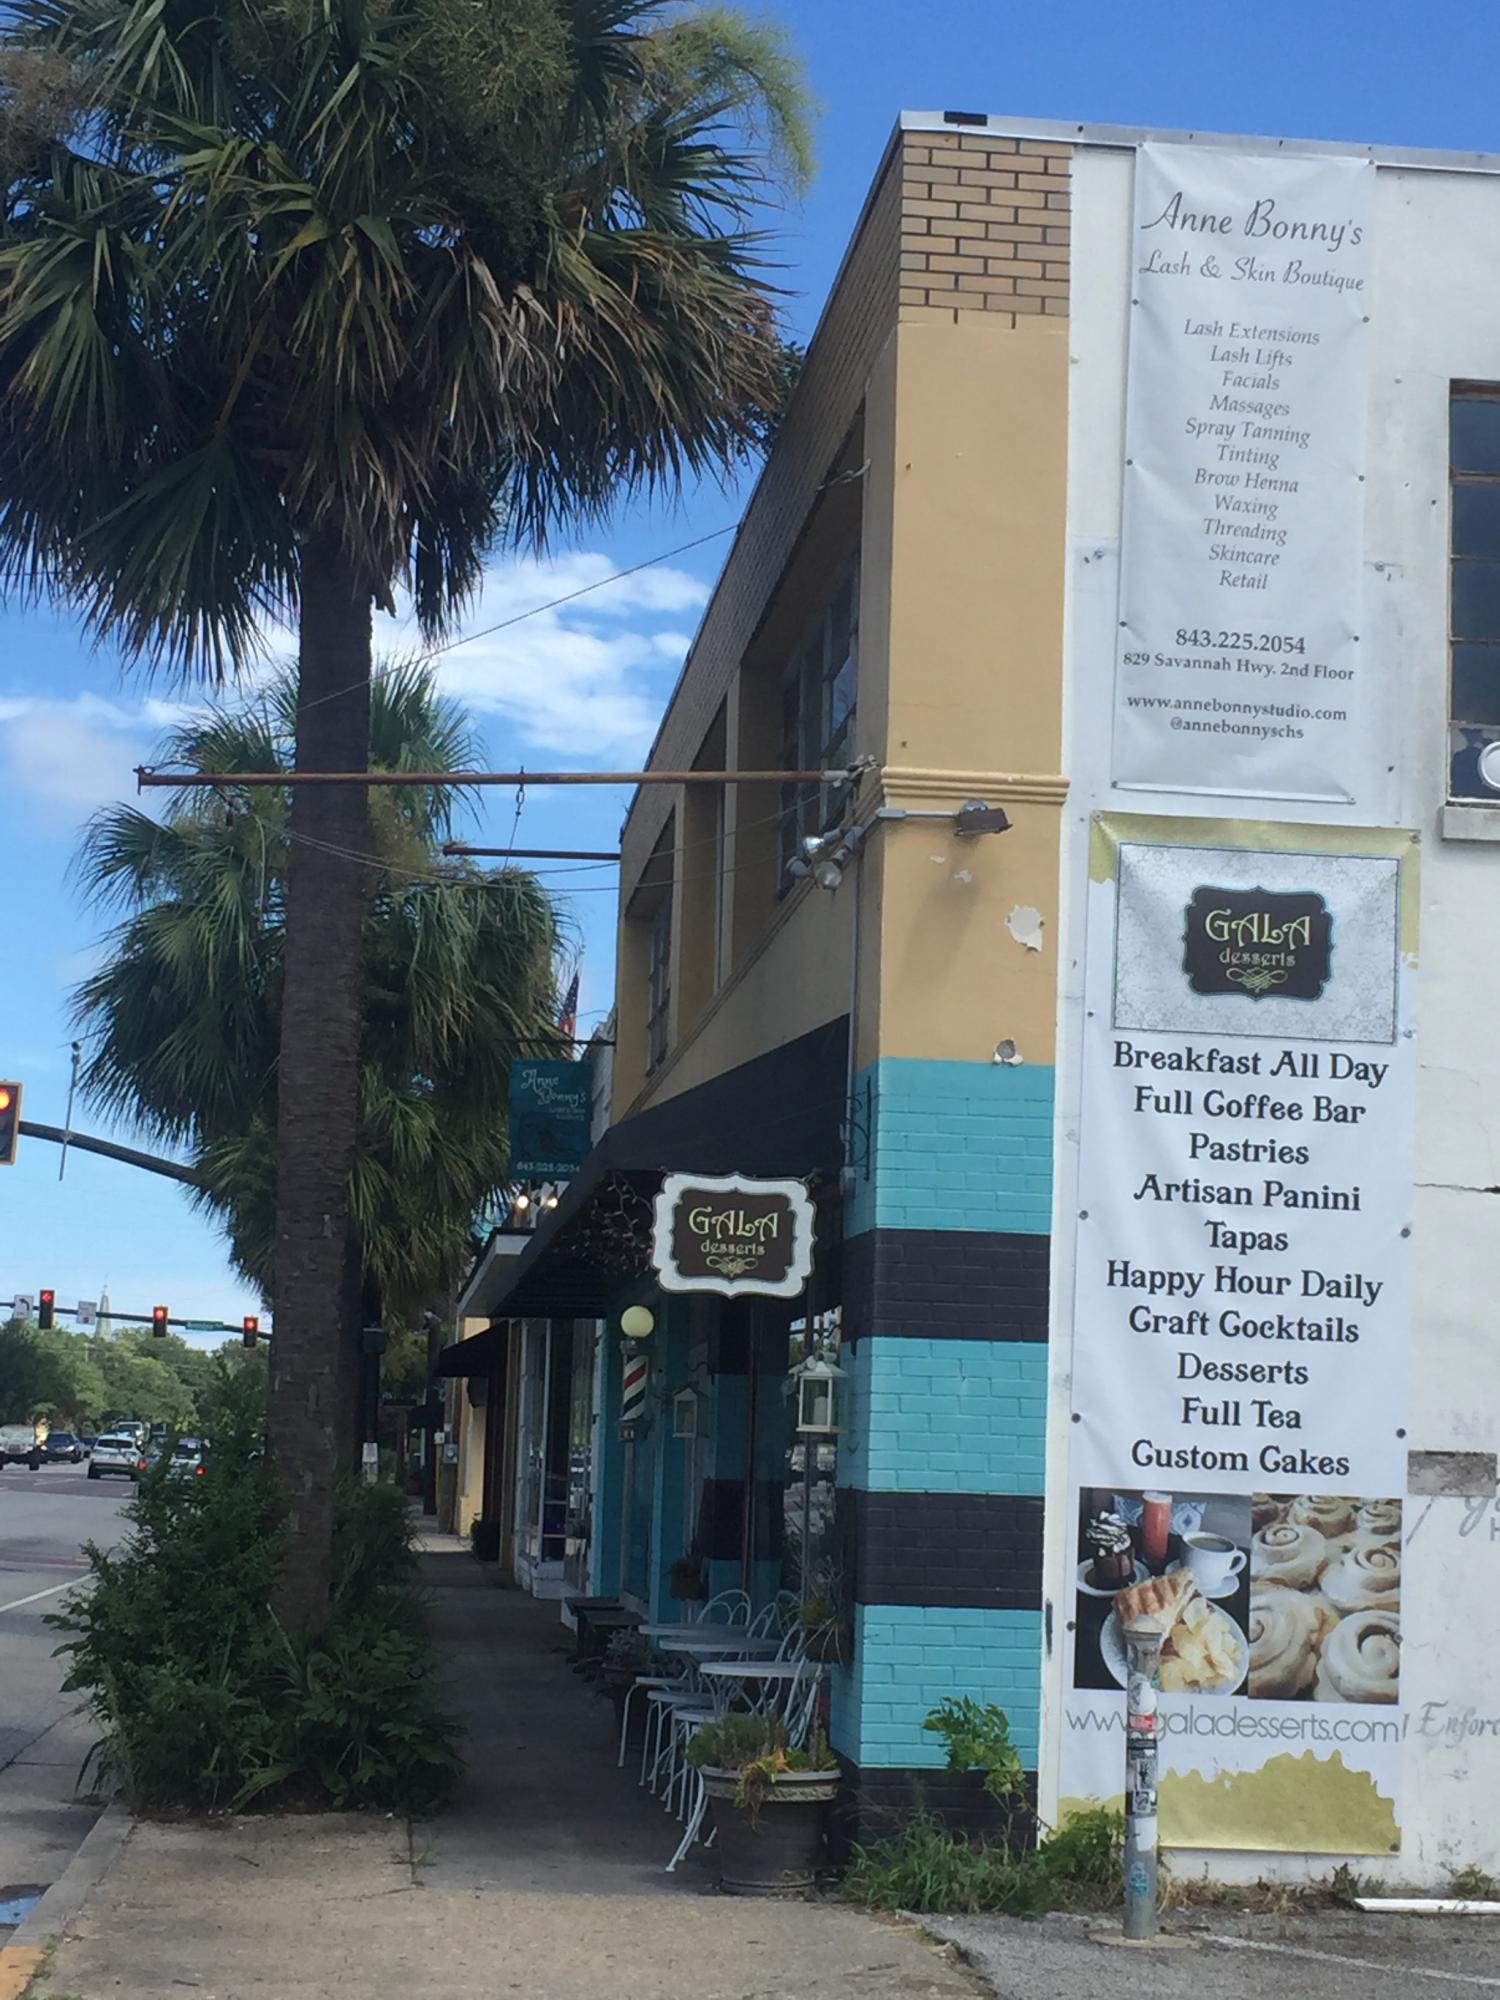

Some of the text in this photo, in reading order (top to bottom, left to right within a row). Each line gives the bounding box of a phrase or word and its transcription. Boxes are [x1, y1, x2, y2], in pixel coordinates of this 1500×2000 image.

[1140, 192, 1364, 251] Anne Bonny's
[1139, 250, 1365, 293] Lash & Skin Boutique
[1184, 319, 1321, 345] Lash Extensions
[1210, 345, 1293, 369] Lash Lifts
[1221, 371, 1280, 391] Facials
[1209, 395, 1290, 419] Massages
[1185, 418, 1311, 449] Spray Tanning
[1216, 445, 1280, 469] Tinting
[1194, 469, 1299, 494] Brow Henna
[1214, 494, 1279, 520] Waxing
[1203, 518, 1288, 546] Threading
[1208, 544, 1280, 566] Skincare
[1219, 570, 1268, 590] Retail
[1176, 628, 1306, 655] 843.225.2054
[1122, 652, 1354, 680] 829 Savannah Hwy. 2nd Floor
[1127, 695, 1347, 721] www.annebonnystudio.com
[1170, 717, 1304, 740] @annebonnyschs
[1205, 908, 1312, 949] GALA
[1219, 948, 1295, 968] desserts
[1112, 1040, 1389, 1088] Breakfast All Day
[1133, 1086, 1366, 1124] Full Coffee Bar
[1189, 1133, 1310, 1165] Pastries
[1133, 1174, 1361, 1211] Artisan Panini
[688, 1206, 779, 1241] GALA
[700, 1240, 765, 1256] desserts
[1204, 1221, 1289, 1255] Tapas
[1106, 1260, 1383, 1307] Happy Hour Daily
[1129, 1305, 1360, 1343] Craft Cocktails
[1177, 1352, 1309, 1385] Desserts
[1181, 1396, 1302, 1429] Full Tea
[1131, 1439, 1350, 1476] Custom Cakes
